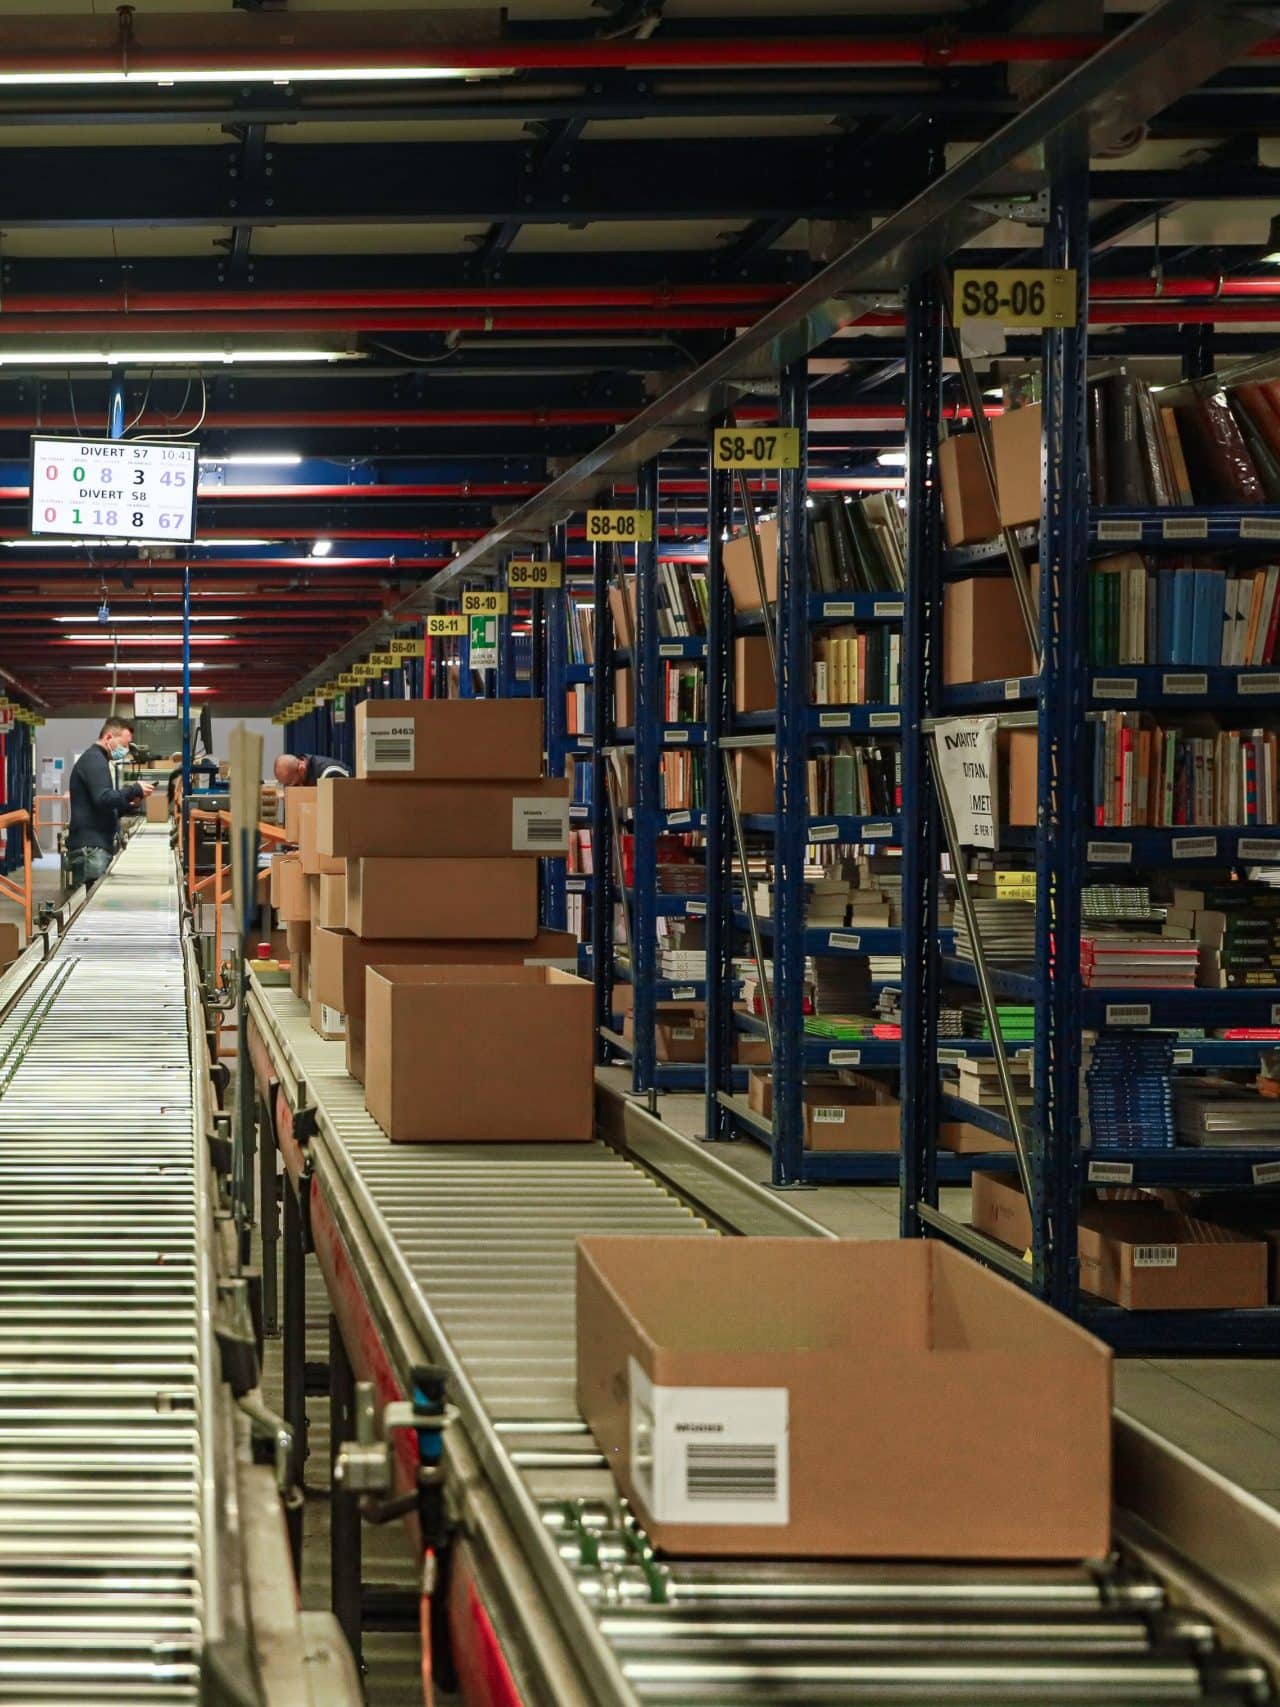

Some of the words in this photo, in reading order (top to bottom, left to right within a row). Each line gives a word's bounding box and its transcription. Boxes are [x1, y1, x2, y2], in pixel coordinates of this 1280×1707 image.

[962, 280, 1045, 316] S8-06
[81, 446, 126, 457] DIVERT
[133, 449, 148, 459] S7
[162, 450, 192, 461] 10:41
[719, 436, 777, 462] S8-07
[46, 465, 58, 481] 0
[73, 466, 86, 482] 0
[100, 467, 112, 484] 8
[133, 469, 145, 485] 3
[159, 471, 186, 487] 45
[79, 488, 124, 500] DIVERT
[131, 491, 147, 501] S8
[44, 507, 57, 523] 0
[72, 509, 83, 524] 1
[93, 510, 118, 526] 18
[132, 512, 144, 528] 8
[158, 513, 184, 529] 67
[590, 516, 635, 535] S8-08
[511, 566, 547, 582] S8-09
[465, 597, 497, 610] S8-10
[430, 620, 459, 631] S8-11
[391, 643, 416, 653] S6-01
